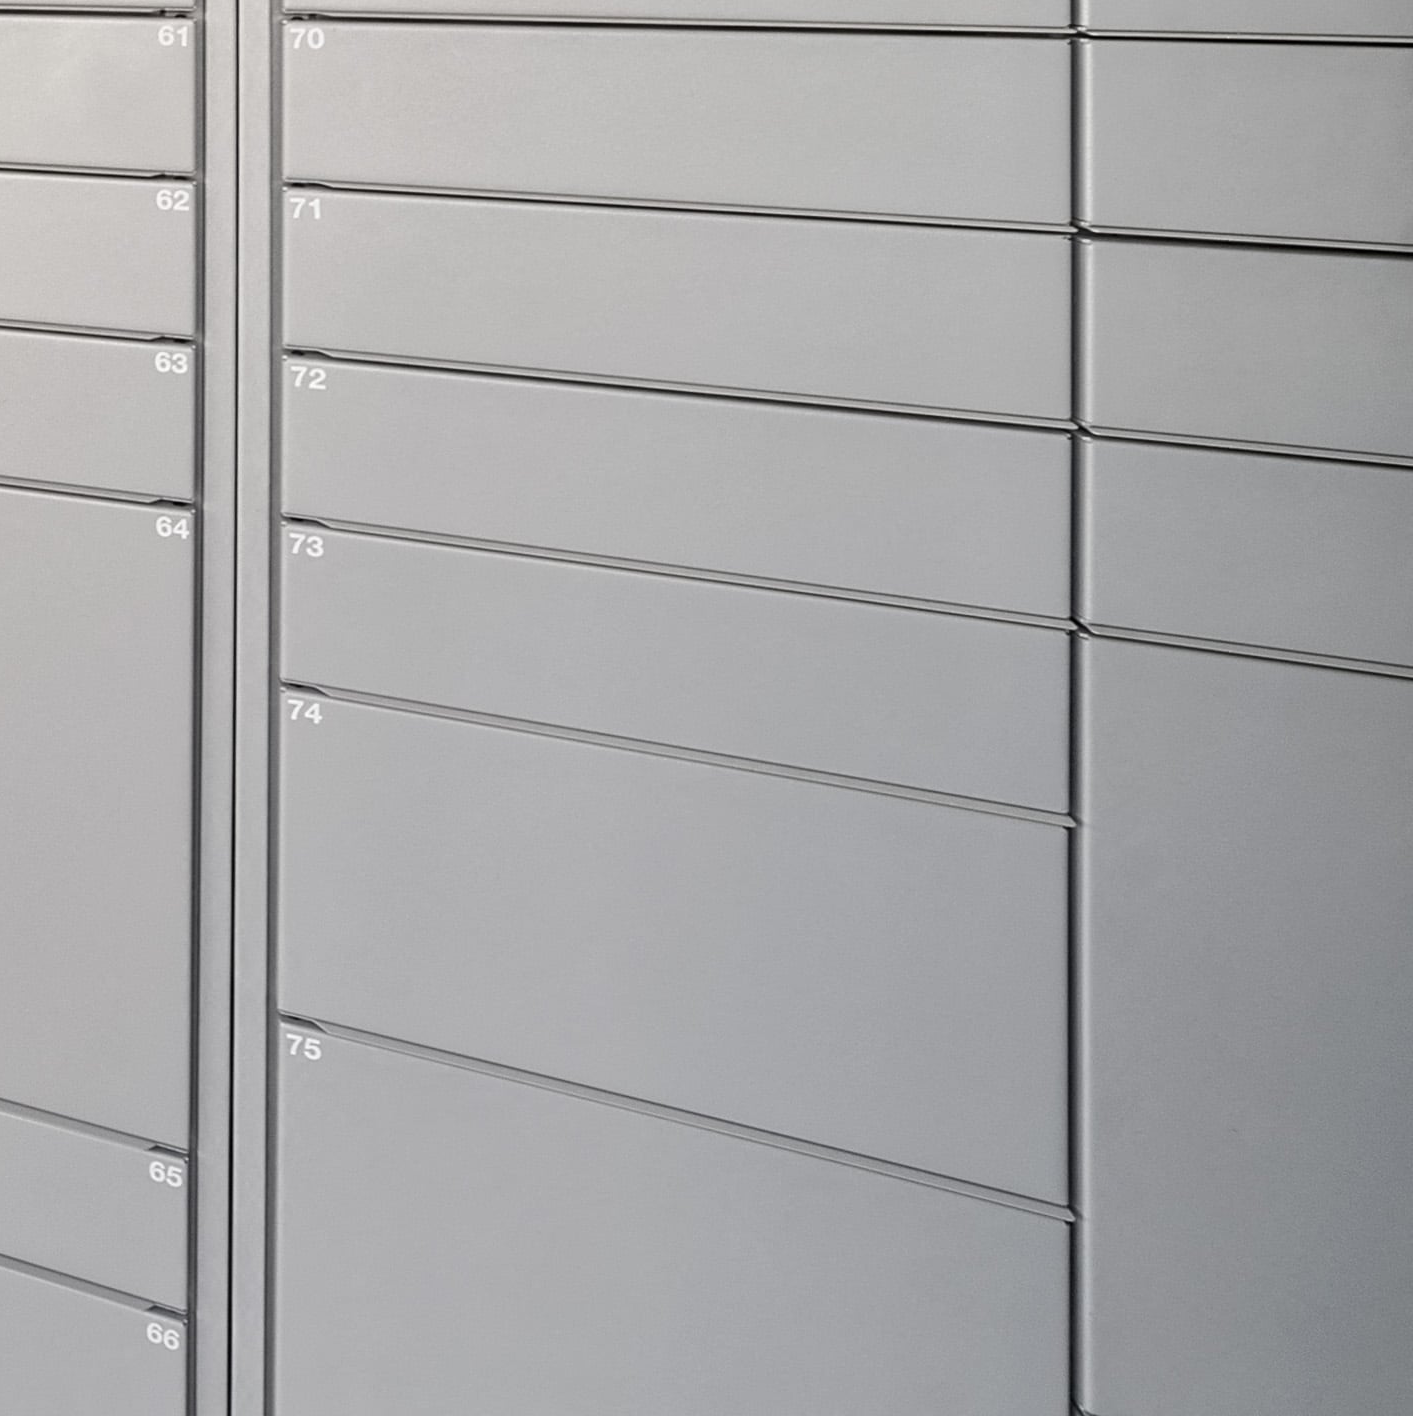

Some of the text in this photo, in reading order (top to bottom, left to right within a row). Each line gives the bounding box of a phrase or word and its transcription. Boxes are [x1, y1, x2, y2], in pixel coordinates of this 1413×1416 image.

[157, 25, 188, 47] 61
[289, 27, 325, 49] 70
[156, 189, 190, 211] 62
[289, 198, 321, 220] 71
[154, 351, 188, 374] 63
[290, 365, 326, 390] 72
[155, 516, 190, 539] 64
[288, 532, 324, 557] 73
[287, 699, 323, 724] 74
[285, 1032, 322, 1061] 75
[148, 1161, 183, 1187] 65
[146, 1322, 180, 1351] 66
